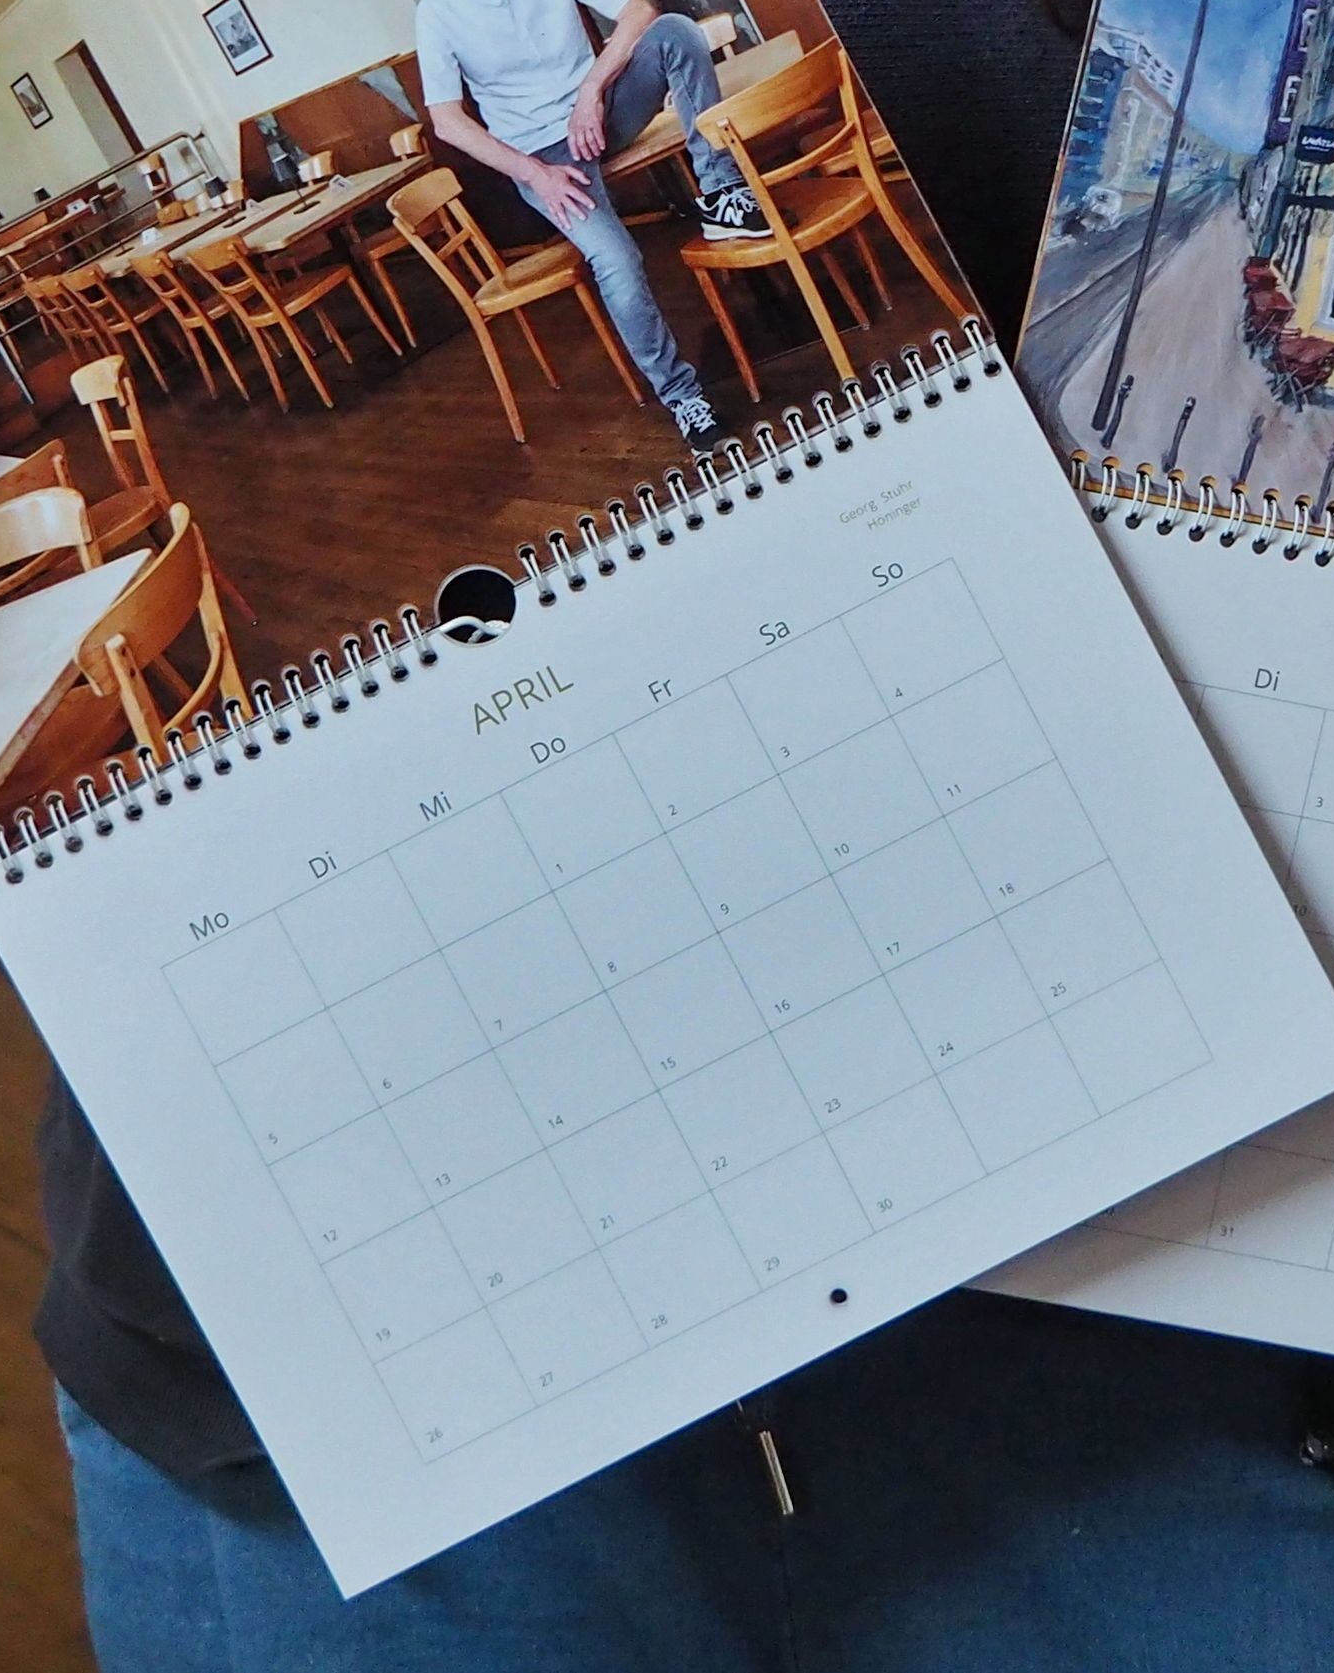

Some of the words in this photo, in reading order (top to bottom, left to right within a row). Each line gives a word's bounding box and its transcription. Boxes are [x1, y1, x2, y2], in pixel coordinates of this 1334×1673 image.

[839, 500, 878, 523] Georg
[188, 912, 230, 941] Mo
[308, 850, 337, 879] Di
[419, 790, 452, 822] Mi
[529, 737, 567, 764] Do
[647, 679, 672, 703] Fr
[759, 621, 791, 646] Sa
[871, 562, 904, 588] So
[473, 665, 574, 734] APRIL
[555, 863, 564, 873] 1
[668, 804, 678, 817] 2
[780, 746, 791, 758] 3
[895, 687, 903, 698] 4
[1254, 668, 1281, 692] Di
[1315, 796, 1324, 808] 3
[268, 1132, 279, 1145] 5
[382, 1078, 393, 1090] 6
[493, 1018, 503, 1032] 7
[607, 961, 617, 974] 8
[720, 903, 730, 915] 9
[834, 842, 850, 857] 10
[946, 783, 962, 797] 11
[322, 1229, 337, 1243] 12
[434, 1173, 452, 1187] 13
[547, 1114, 564, 1129] 14
[660, 1056, 677, 1071] 15
[774, 999, 791, 1014] 16
[886, 941, 900, 956] 17
[998, 882, 1015, 897] 18
[375, 1327, 391, 1342] 19
[487, 1271, 504, 1288] 20
[599, 1214, 615, 1230] 21
[711, 1155, 729, 1172] 22
[823, 1097, 842, 1114] 23
[938, 1041, 954, 1057] 24
[1050, 981, 1067, 998] 25
[426, 1427, 444, 1444] 26
[538, 1371, 554, 1388] 27
[650, 1314, 668, 1330] 28
[763, 1256, 781, 1272] 29
[876, 1197, 893, 1213] 30
